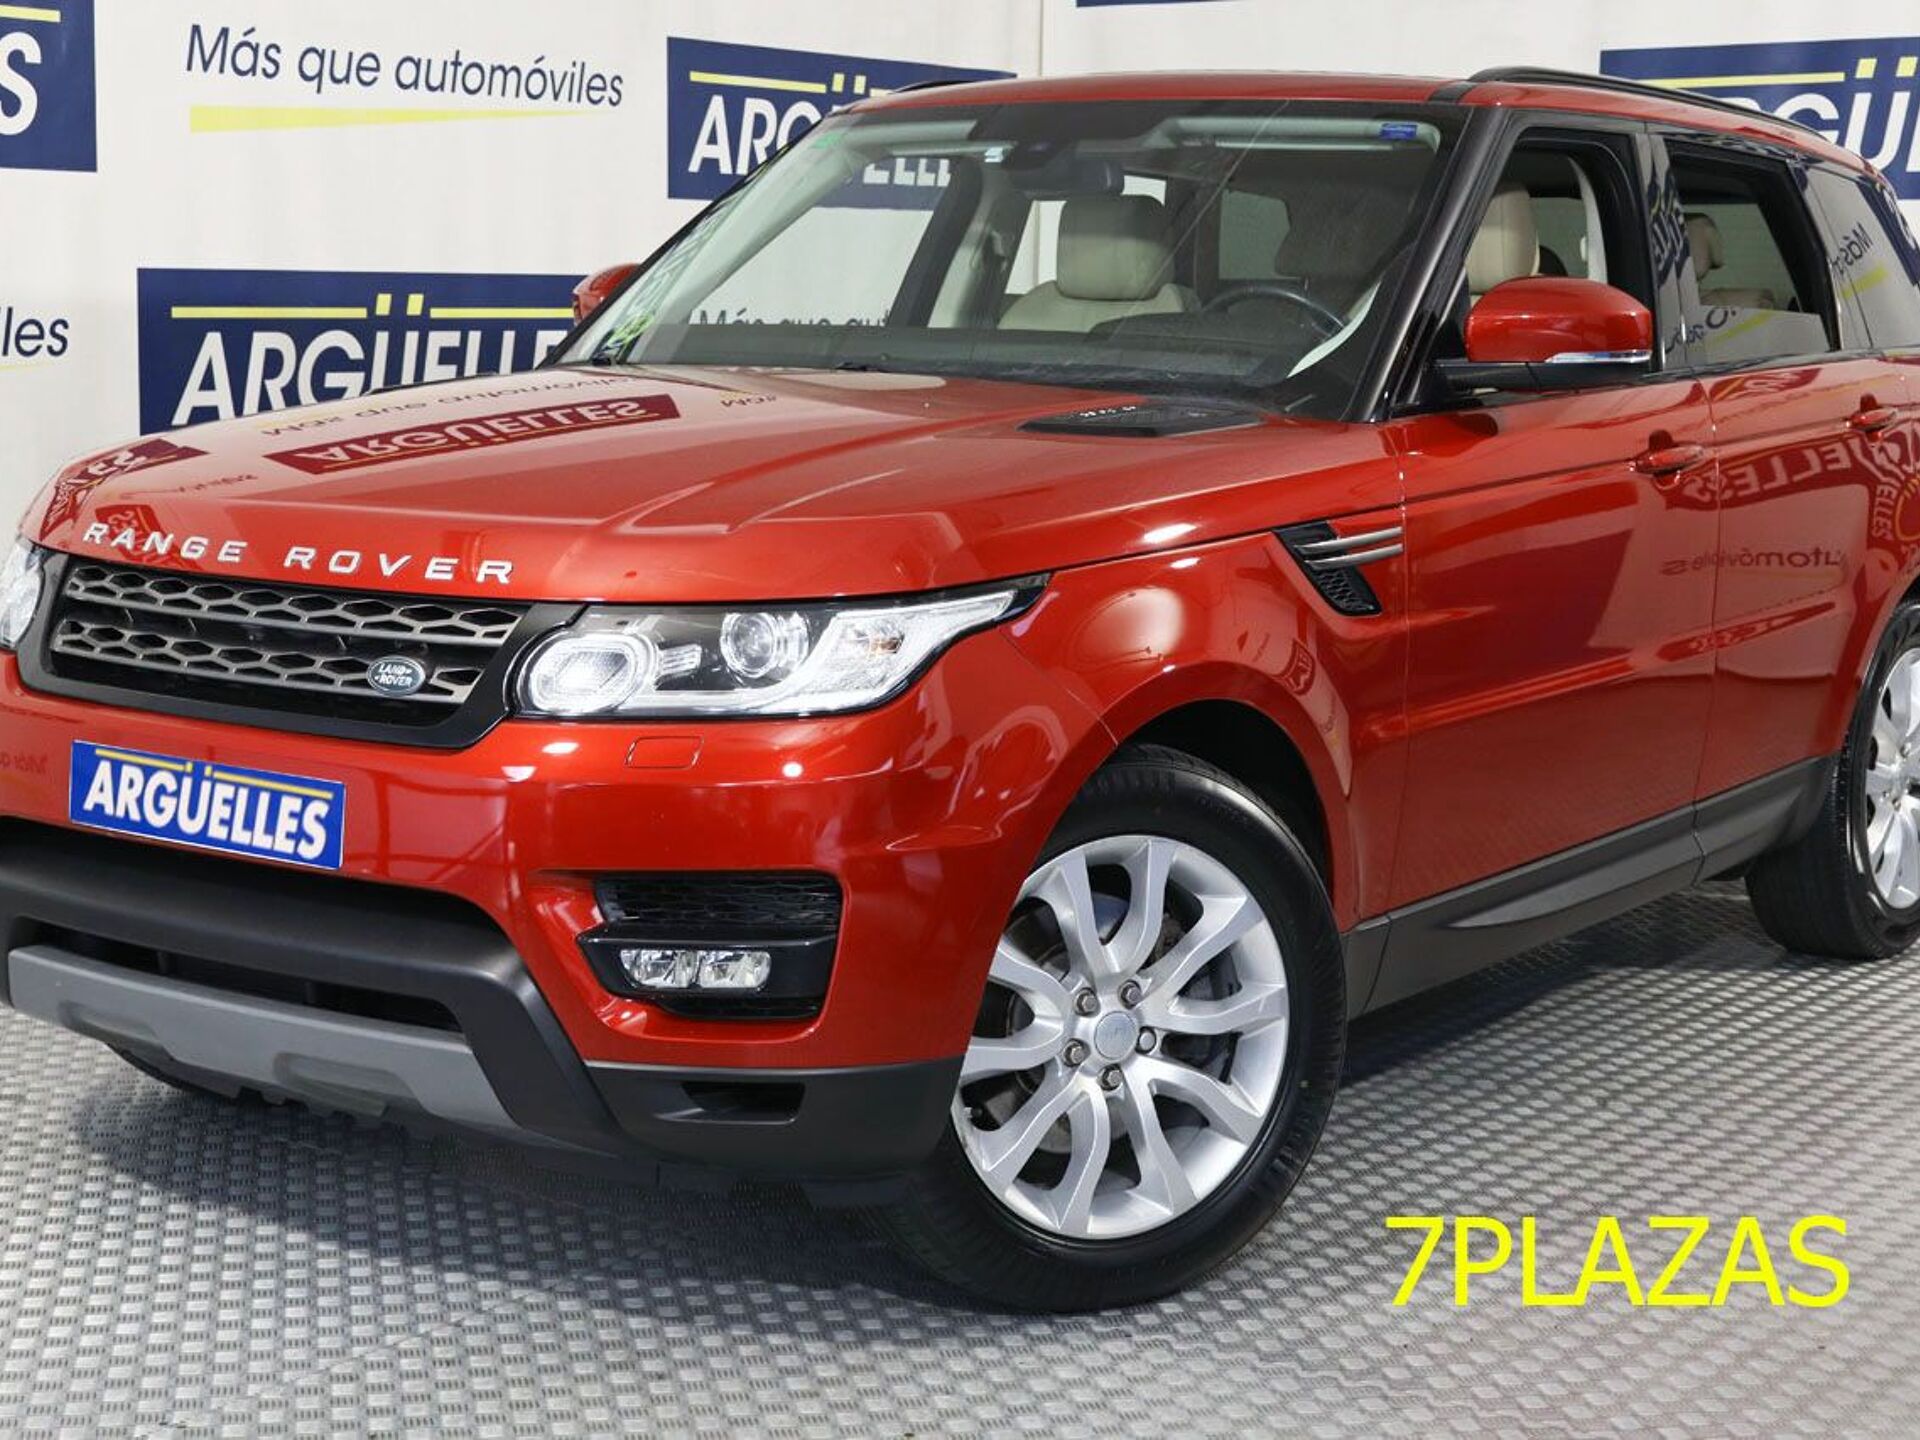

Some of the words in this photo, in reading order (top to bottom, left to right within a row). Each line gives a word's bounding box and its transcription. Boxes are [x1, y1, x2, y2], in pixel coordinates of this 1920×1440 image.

[186, 24, 282, 79] Más
[299, 45, 380, 94] que
[394, 49, 624, 108] automóviles
[82, 521, 249, 564] RANGE
[283, 545, 515, 585] ROVER
[83, 759, 329, 861] ARGÜELLES
